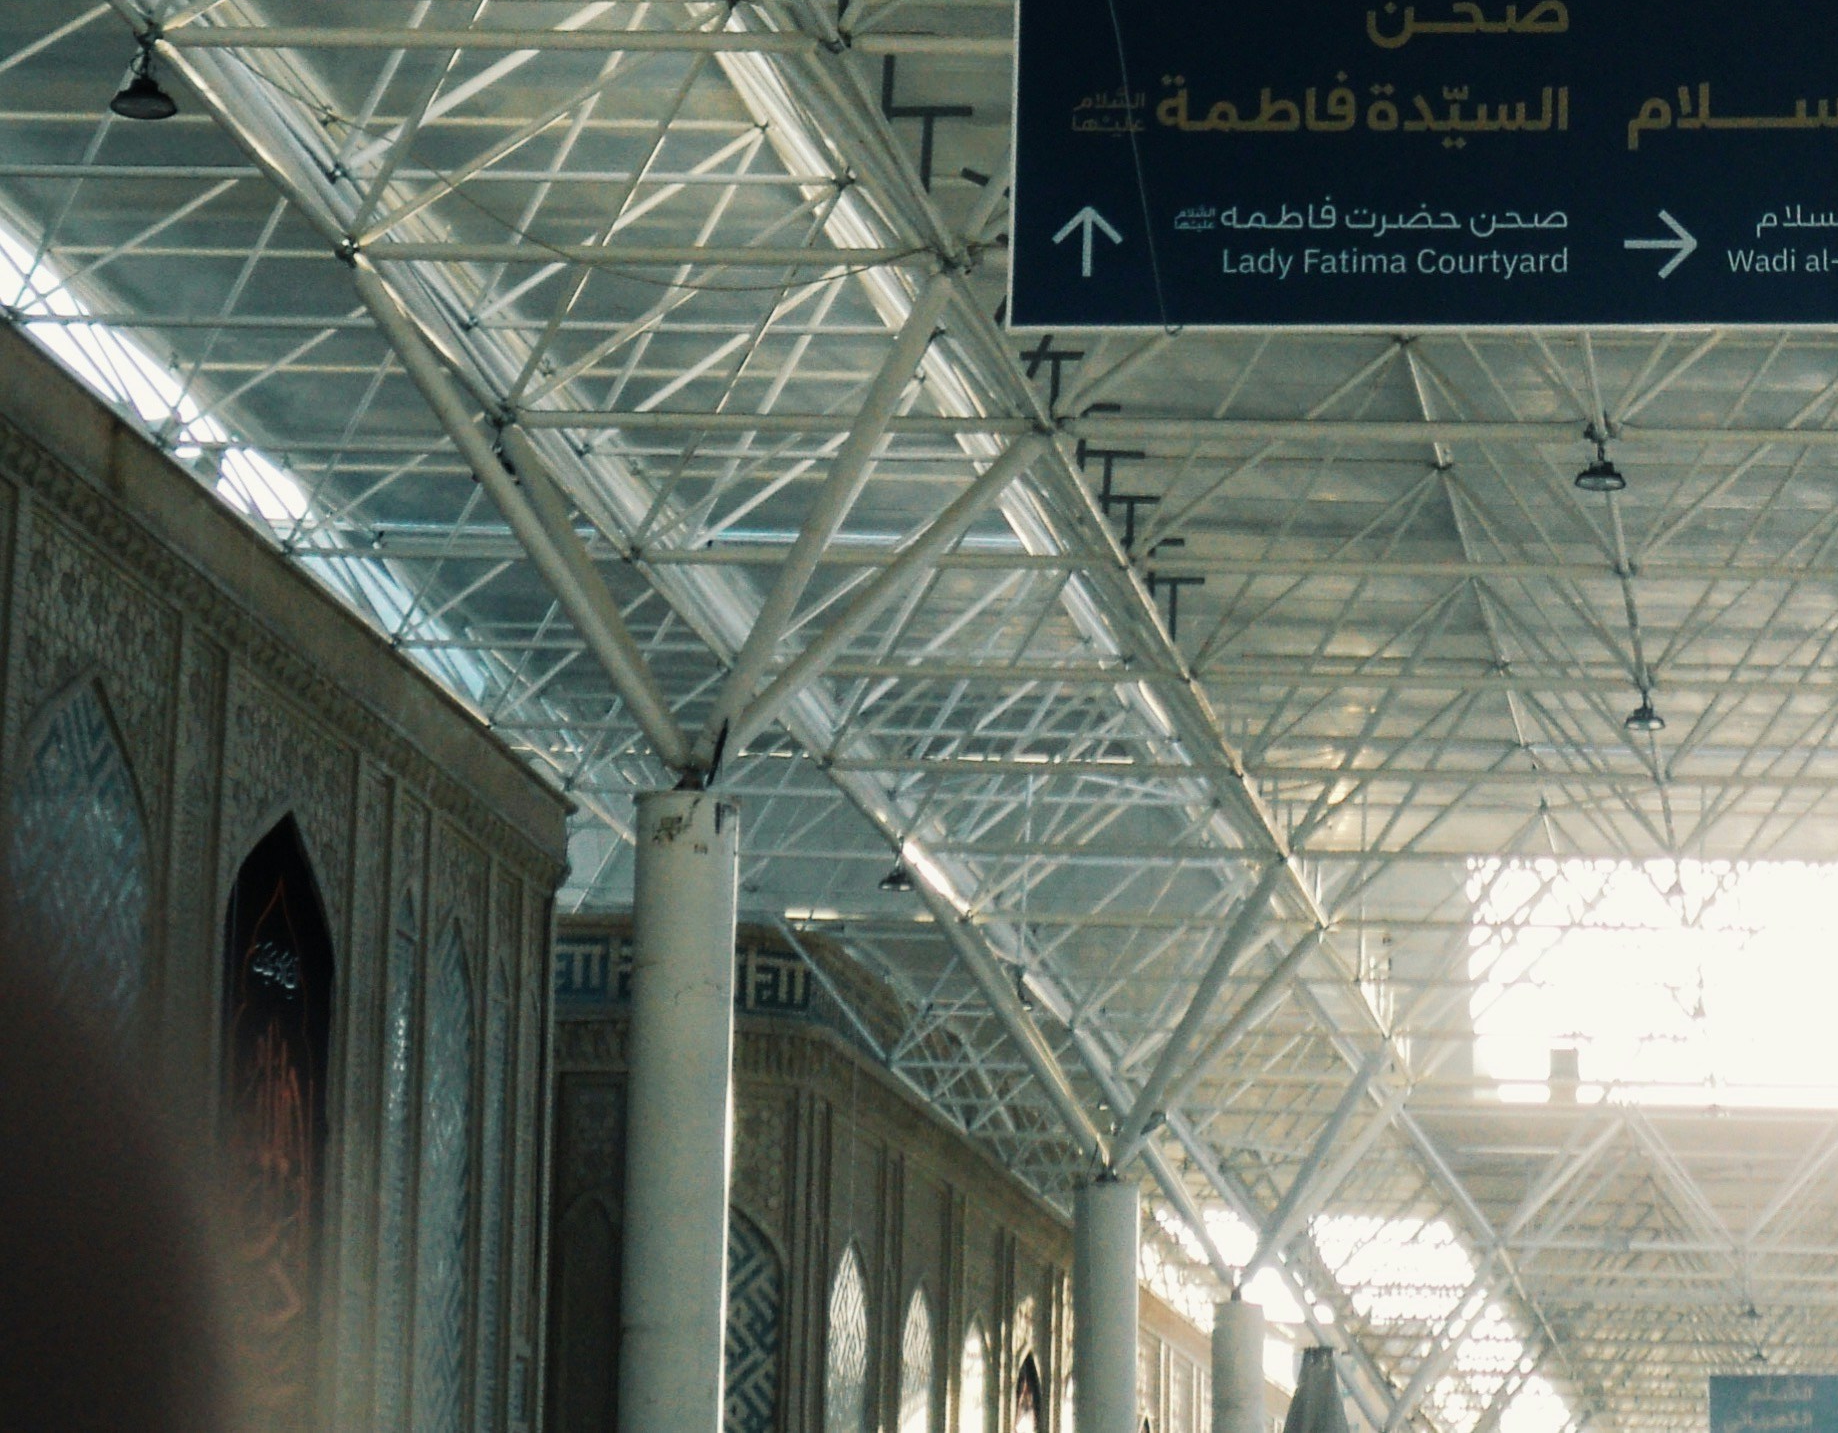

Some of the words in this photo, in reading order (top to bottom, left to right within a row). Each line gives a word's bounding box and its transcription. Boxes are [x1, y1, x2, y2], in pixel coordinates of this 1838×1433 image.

[1366, 0, 1570, 49] صحن
[1156, 71, 1357, 132] فاطمة
[1220, 196, 1337, 230] فاطمه
[1345, 203, 1462, 238] حضرت
[1469, 211, 1569, 238] صحن
[1223, 247, 1294, 280] Lady
[1304, 248, 1407, 274] Fatima
[1417, 246, 1568, 280] Courtyard
[1727, 248, 1796, 273] Wadi
